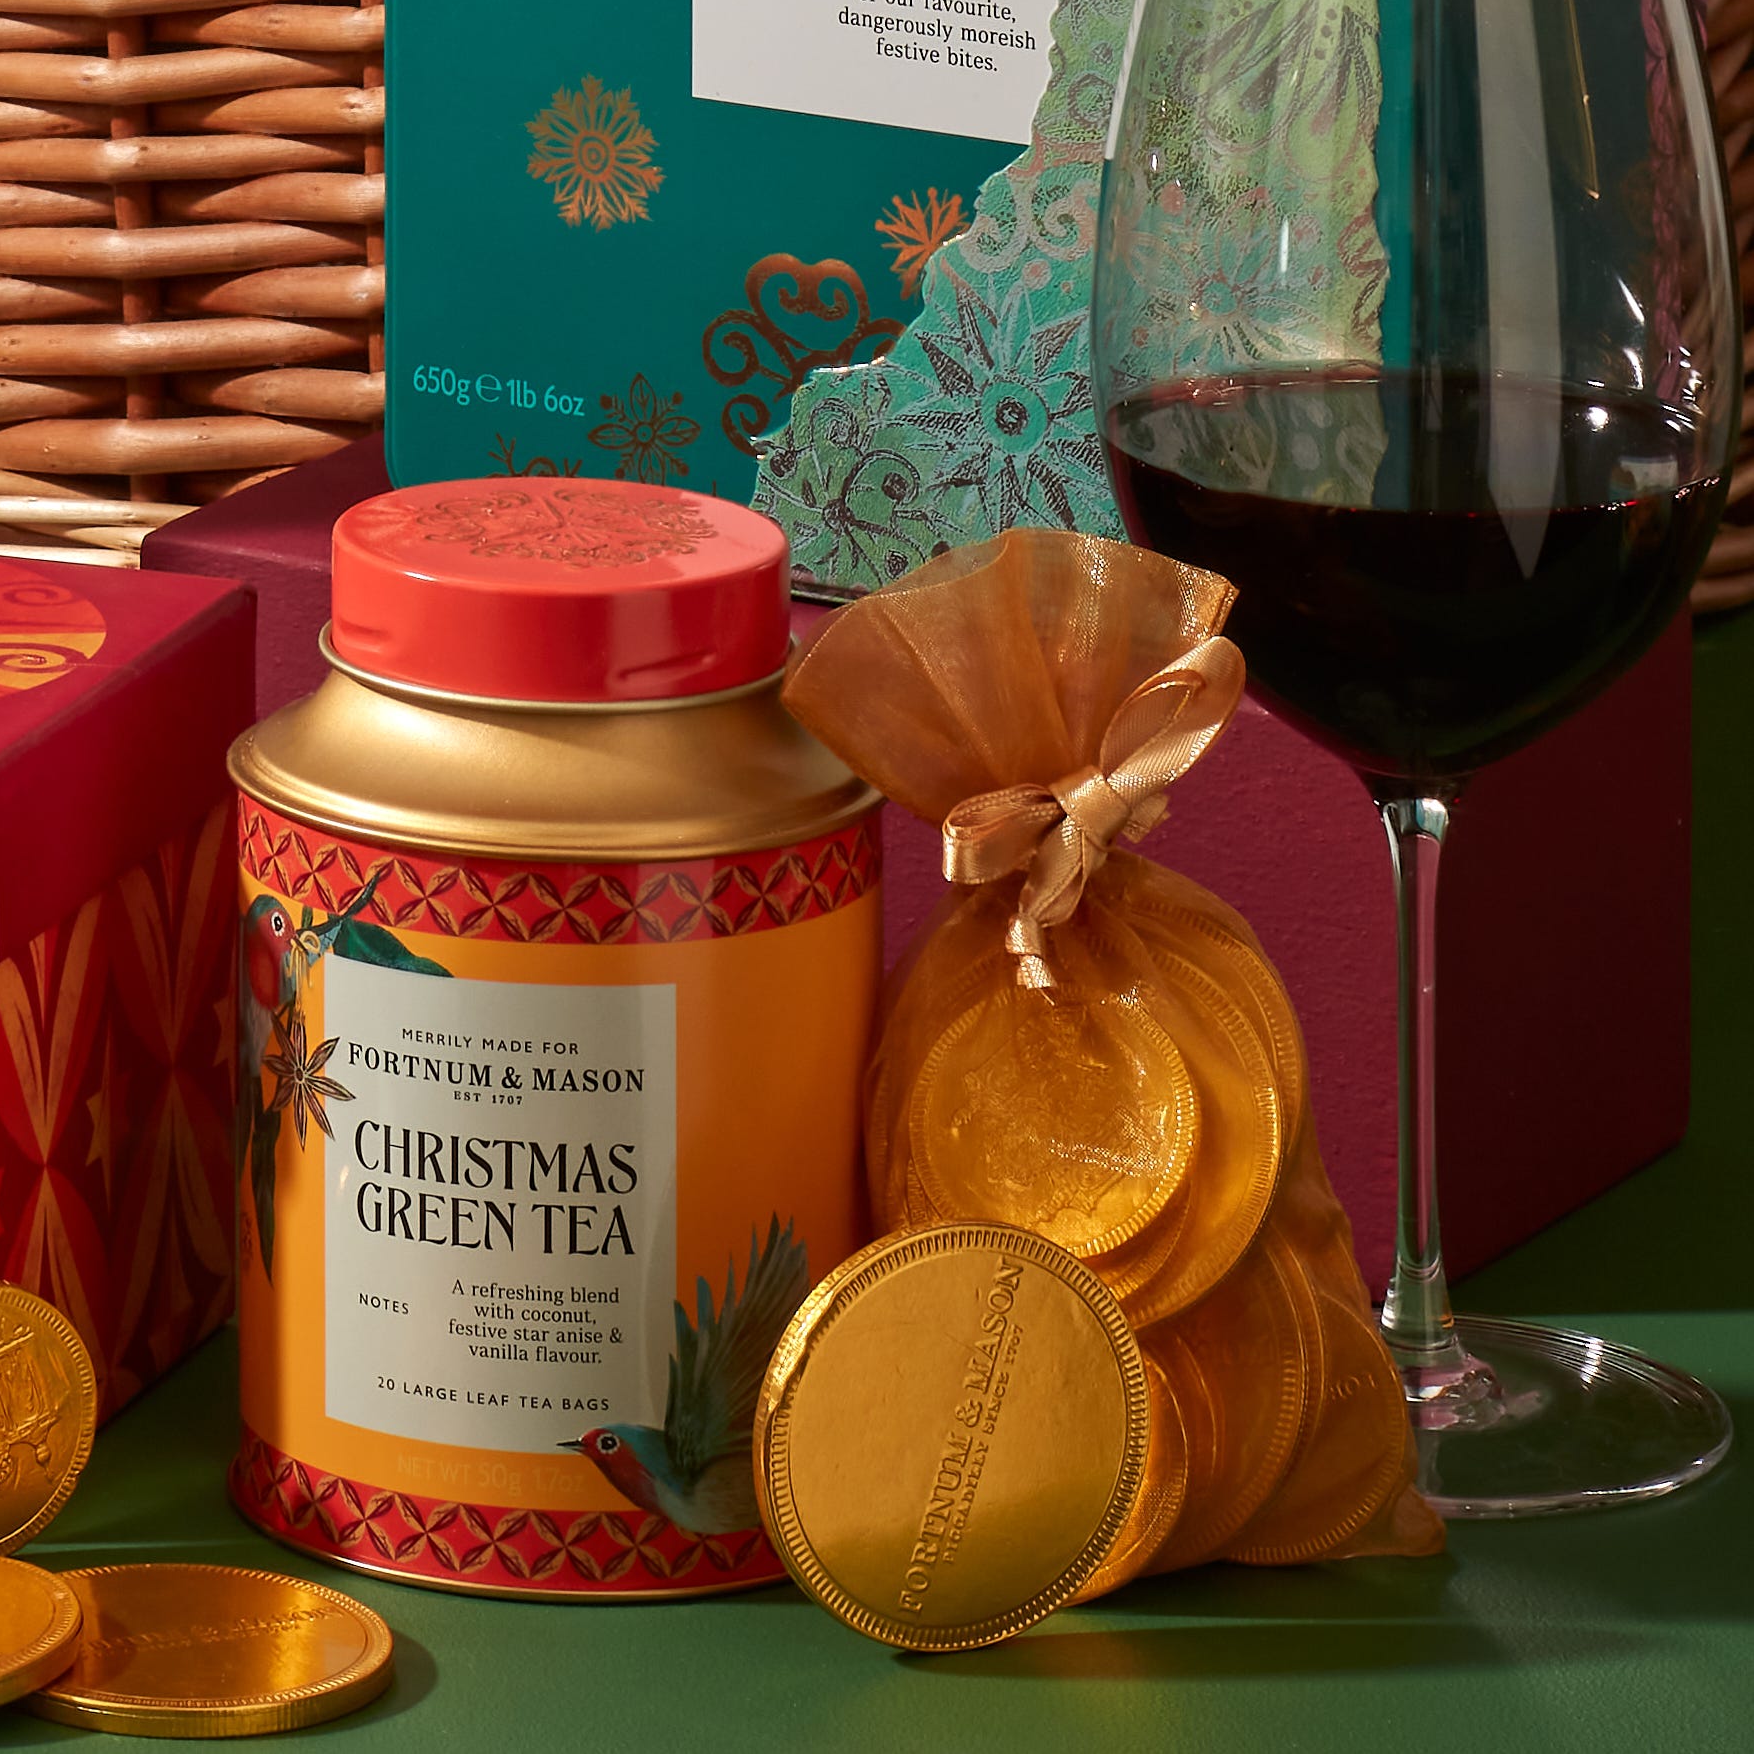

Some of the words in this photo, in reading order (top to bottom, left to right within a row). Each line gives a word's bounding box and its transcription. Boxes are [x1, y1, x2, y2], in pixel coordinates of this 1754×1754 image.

[876, 36, 940, 64] festive
[946, 45, 998, 72] bites.
[402, 1027, 473, 1049] MERRILY
[482, 1037, 533, 1054] MADE
[542, 1041, 579, 1056] FOR
[347, 1041, 493, 1088] FORTNUM
[500, 1065, 524, 1090] &
[531, 1067, 645, 1093] MASON
[354, 1119, 638, 1195] CHRISTMAS
[356, 1181, 517, 1253] GREEN
[530, 1203, 636, 1256] TEA
[359, 1292, 409, 1315] NOTES
[451, 1278, 465, 1296] A
[471, 1282, 565, 1307] refreshing
[570, 1286, 620, 1304] blend
[967, 1256, 1025, 1396] MASON
[377, 1375, 395, 1391] 20
[403, 1381, 457, 1402] LARGE
[466, 1390, 509, 1407] LEAF
[518, 1395, 553, 1410] TEA
[562, 1397, 610, 1412] BAGS
[955, 1398, 983, 1429] &
[898, 1433, 974, 1619] FORTNUM
